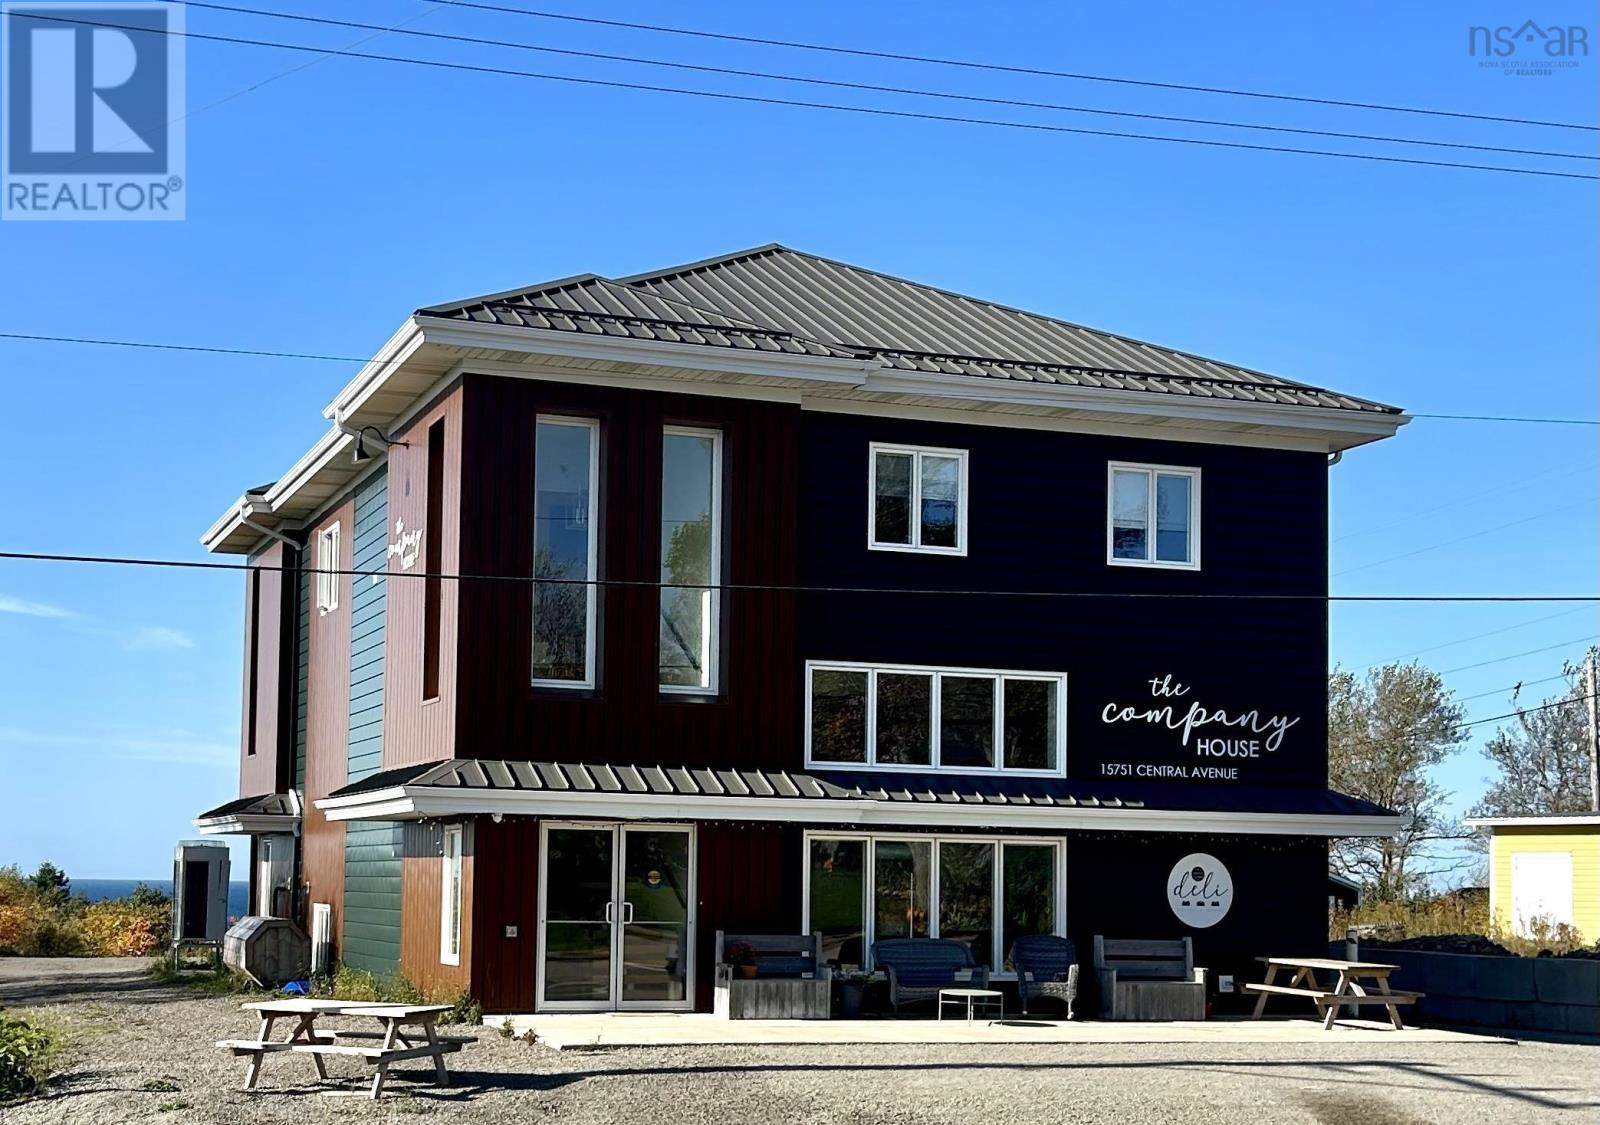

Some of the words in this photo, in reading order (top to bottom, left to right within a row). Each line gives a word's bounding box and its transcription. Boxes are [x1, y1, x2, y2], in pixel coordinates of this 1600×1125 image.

[1148, 674, 1190, 697] the
[1102, 701, 1301, 752] company
[1196, 738, 1260, 758] HOUSE
[1100, 763, 1132, 776] 15751
[1136, 764, 1189, 778] CENTRAL
[1191, 767, 1239, 780] AVENUE
[1173, 871, 1229, 899] deli
